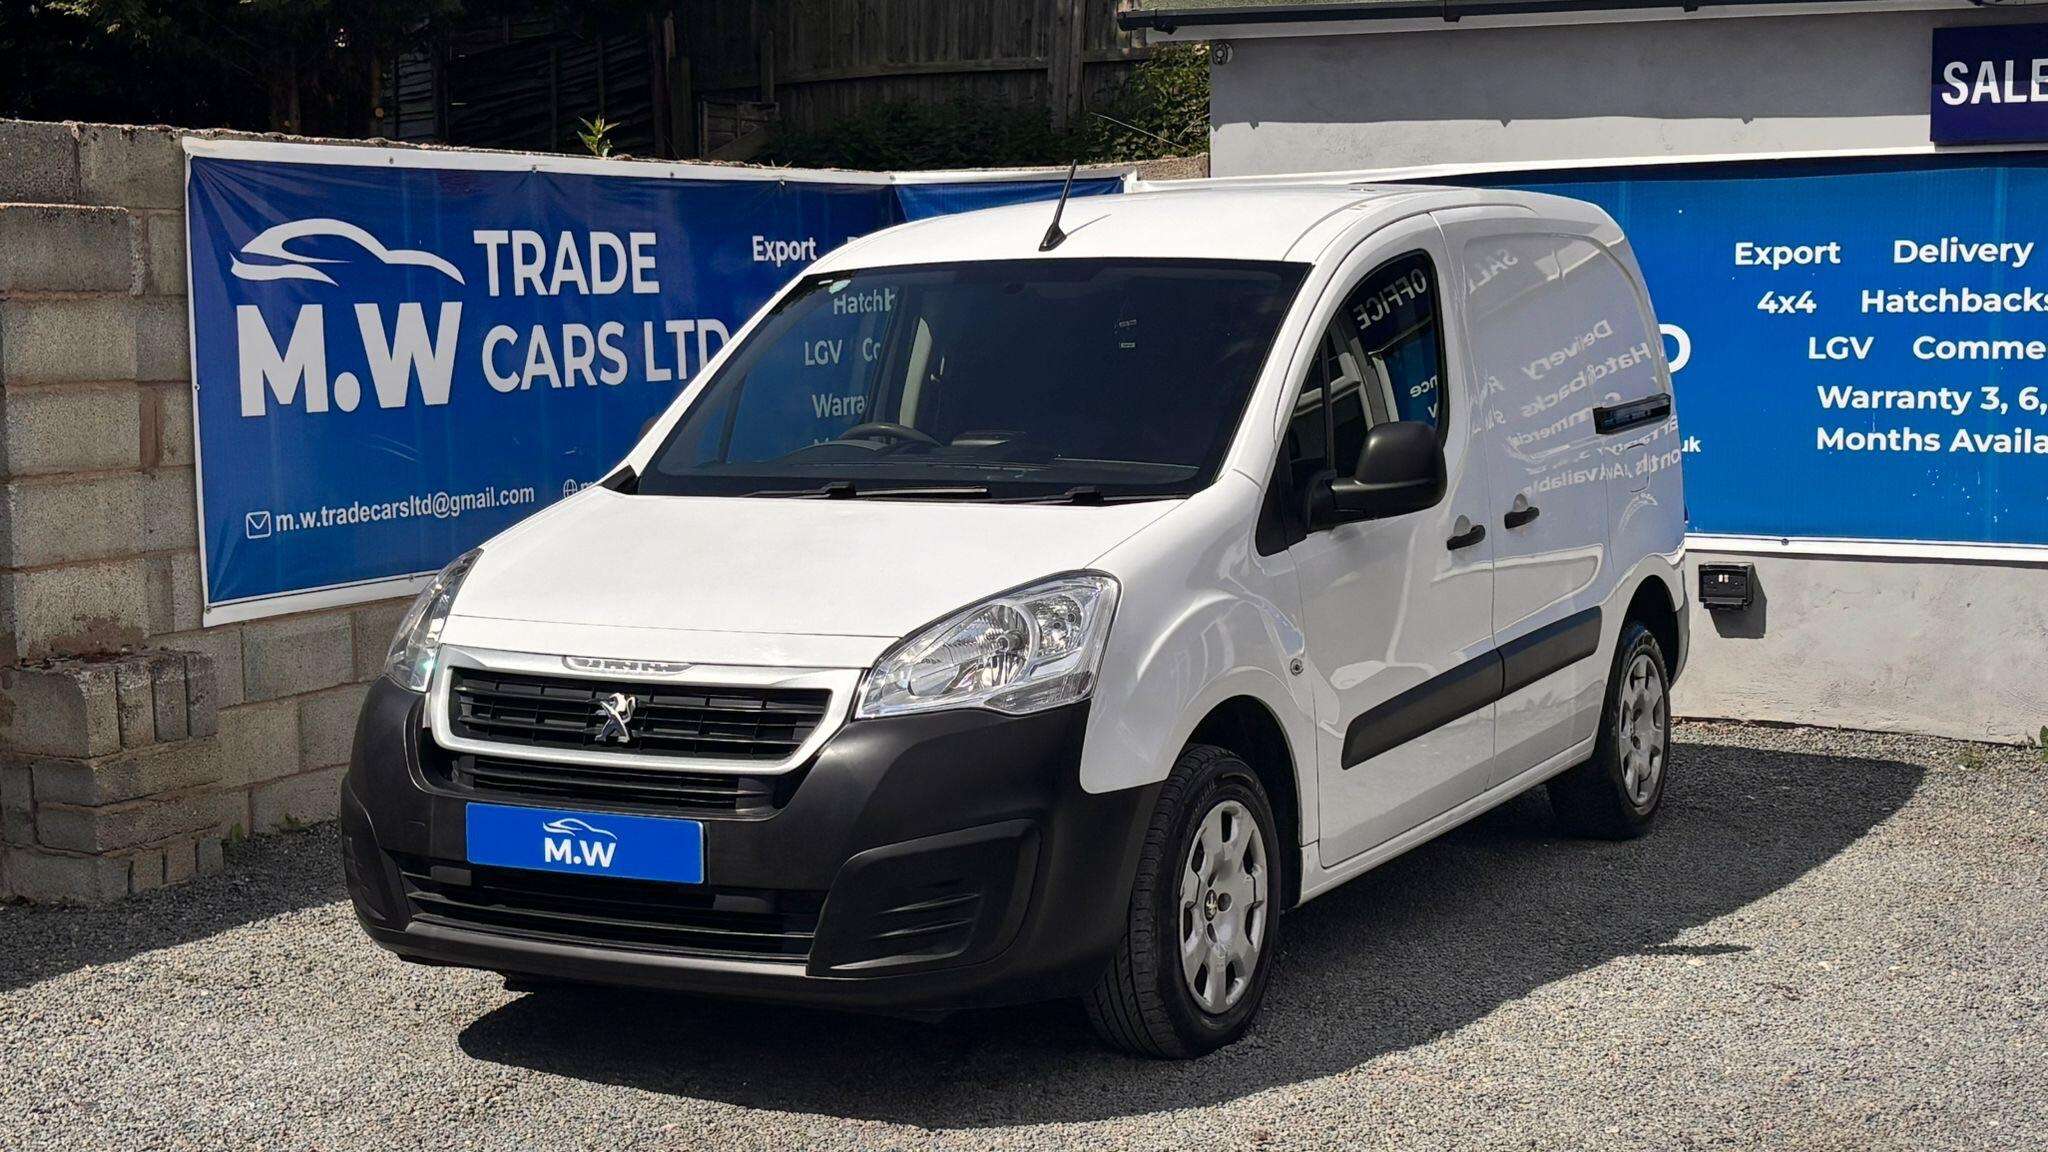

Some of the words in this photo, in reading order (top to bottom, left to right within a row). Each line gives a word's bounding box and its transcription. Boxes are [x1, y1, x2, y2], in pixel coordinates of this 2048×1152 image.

[473, 230, 661, 297] TRADE
[752, 235, 817, 268] Export
[1734, 241, 1841, 270] Export
[1893, 236, 2034, 268] Delivery
[1757, 290, 1817, 314] 4x4
[236, 301, 463, 418] M.W
[481, 320, 628, 393] CARS
[644, 318, 730, 382] LTD
[804, 339, 843, 366] LGV
[1808, 336, 1874, 360] LGV
[1817, 385, 1972, 416] Warranty
[1980, 386, 2008, 415] 3,
[1816, 427, 1940, 452] Months
[275, 485, 535, 532] m.w.tradecarsltd@gmail.com
[544, 836, 617, 868] M.W
